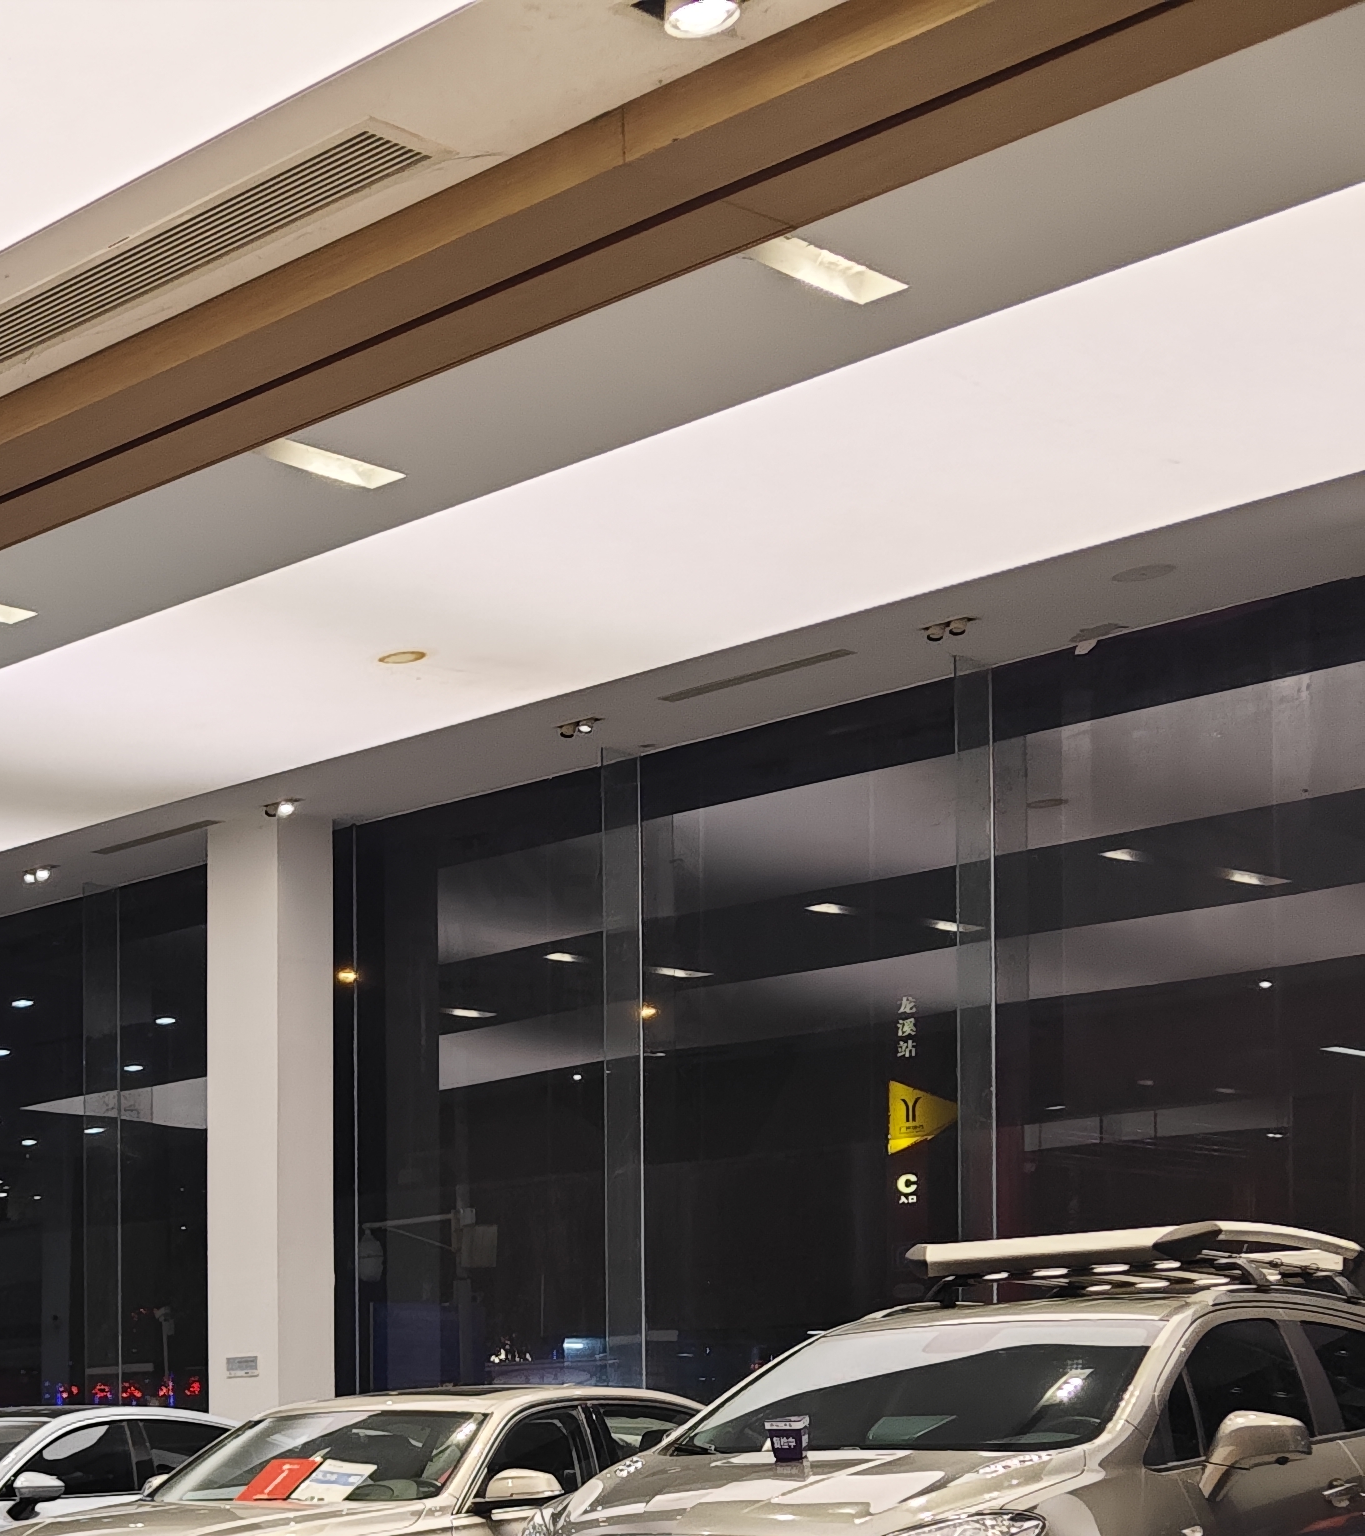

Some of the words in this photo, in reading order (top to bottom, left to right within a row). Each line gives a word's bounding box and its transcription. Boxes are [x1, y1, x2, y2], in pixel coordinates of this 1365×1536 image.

[896, 996, 917, 1058] 龙溪站
[896, 1173, 918, 1194] C
